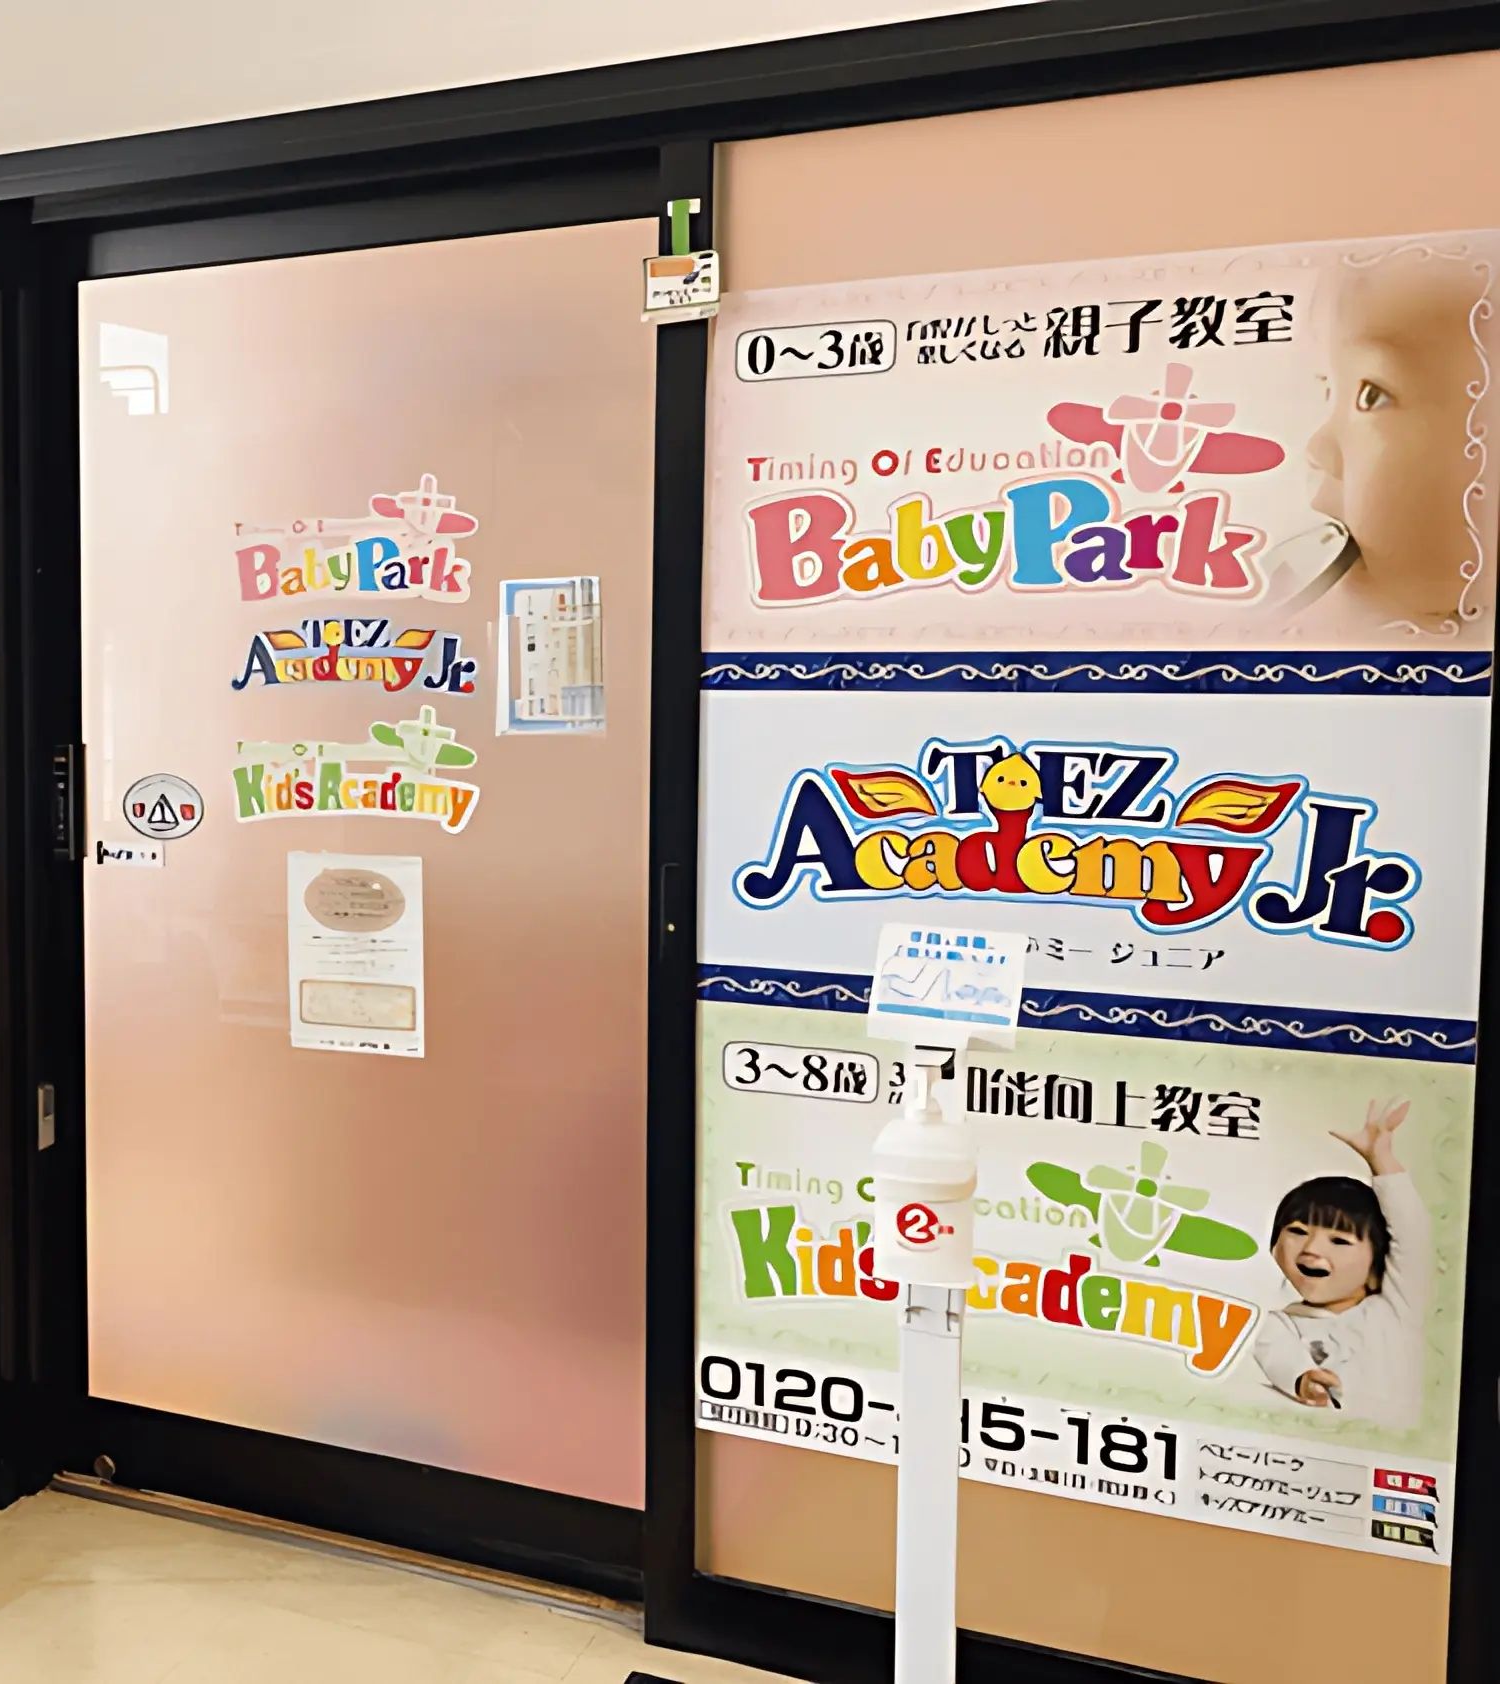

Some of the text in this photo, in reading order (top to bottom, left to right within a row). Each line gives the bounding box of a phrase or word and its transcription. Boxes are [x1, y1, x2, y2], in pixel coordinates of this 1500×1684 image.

[747, 453, 859, 486] Timing
[747, 477, 1257, 602] BabyPark
[742, 769, 1407, 944] Academy Jr.
